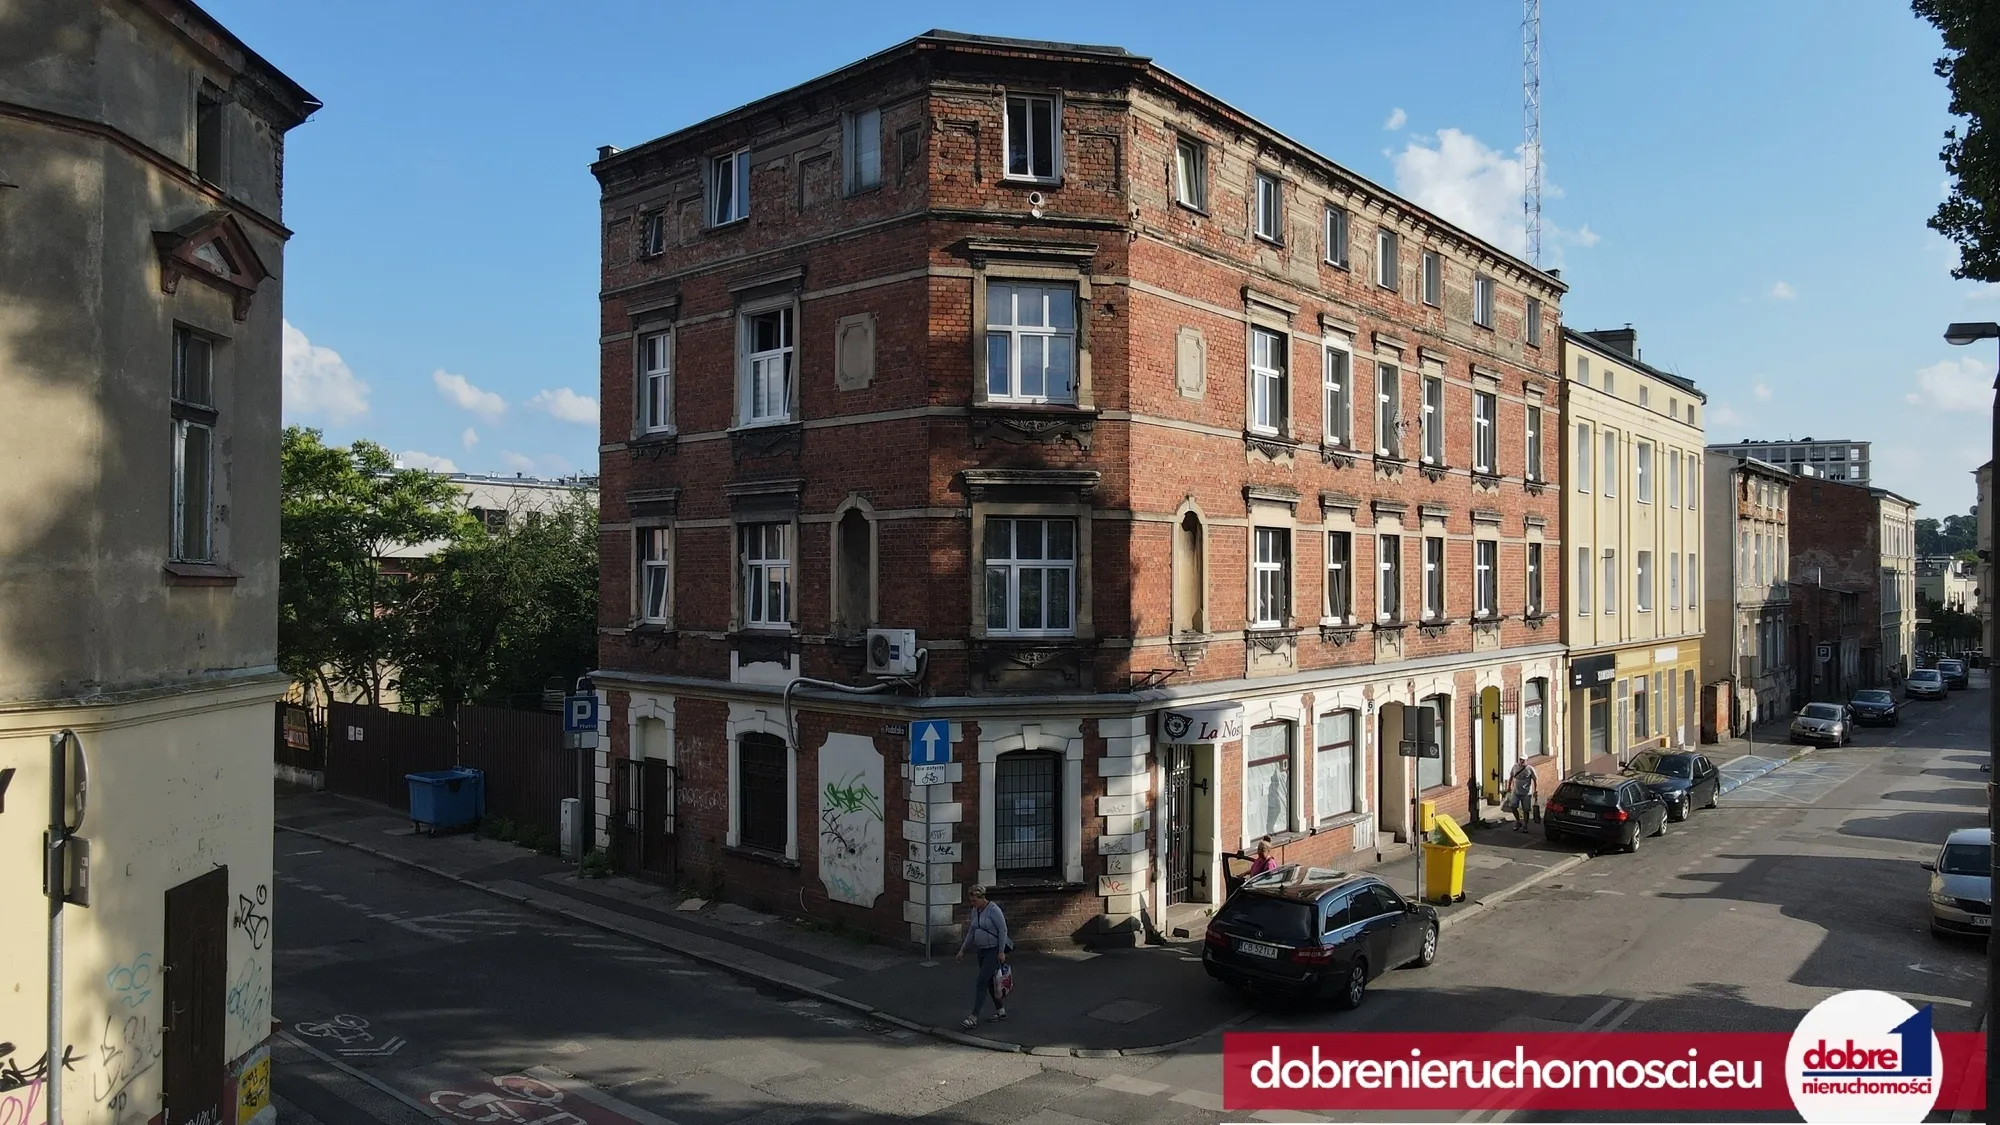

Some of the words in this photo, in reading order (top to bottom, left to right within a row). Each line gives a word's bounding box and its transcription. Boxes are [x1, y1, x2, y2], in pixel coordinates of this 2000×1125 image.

[572, 701, 592, 728] P
[1197, 721, 1218, 740] La
[1243, 942, 1253, 951] CB
